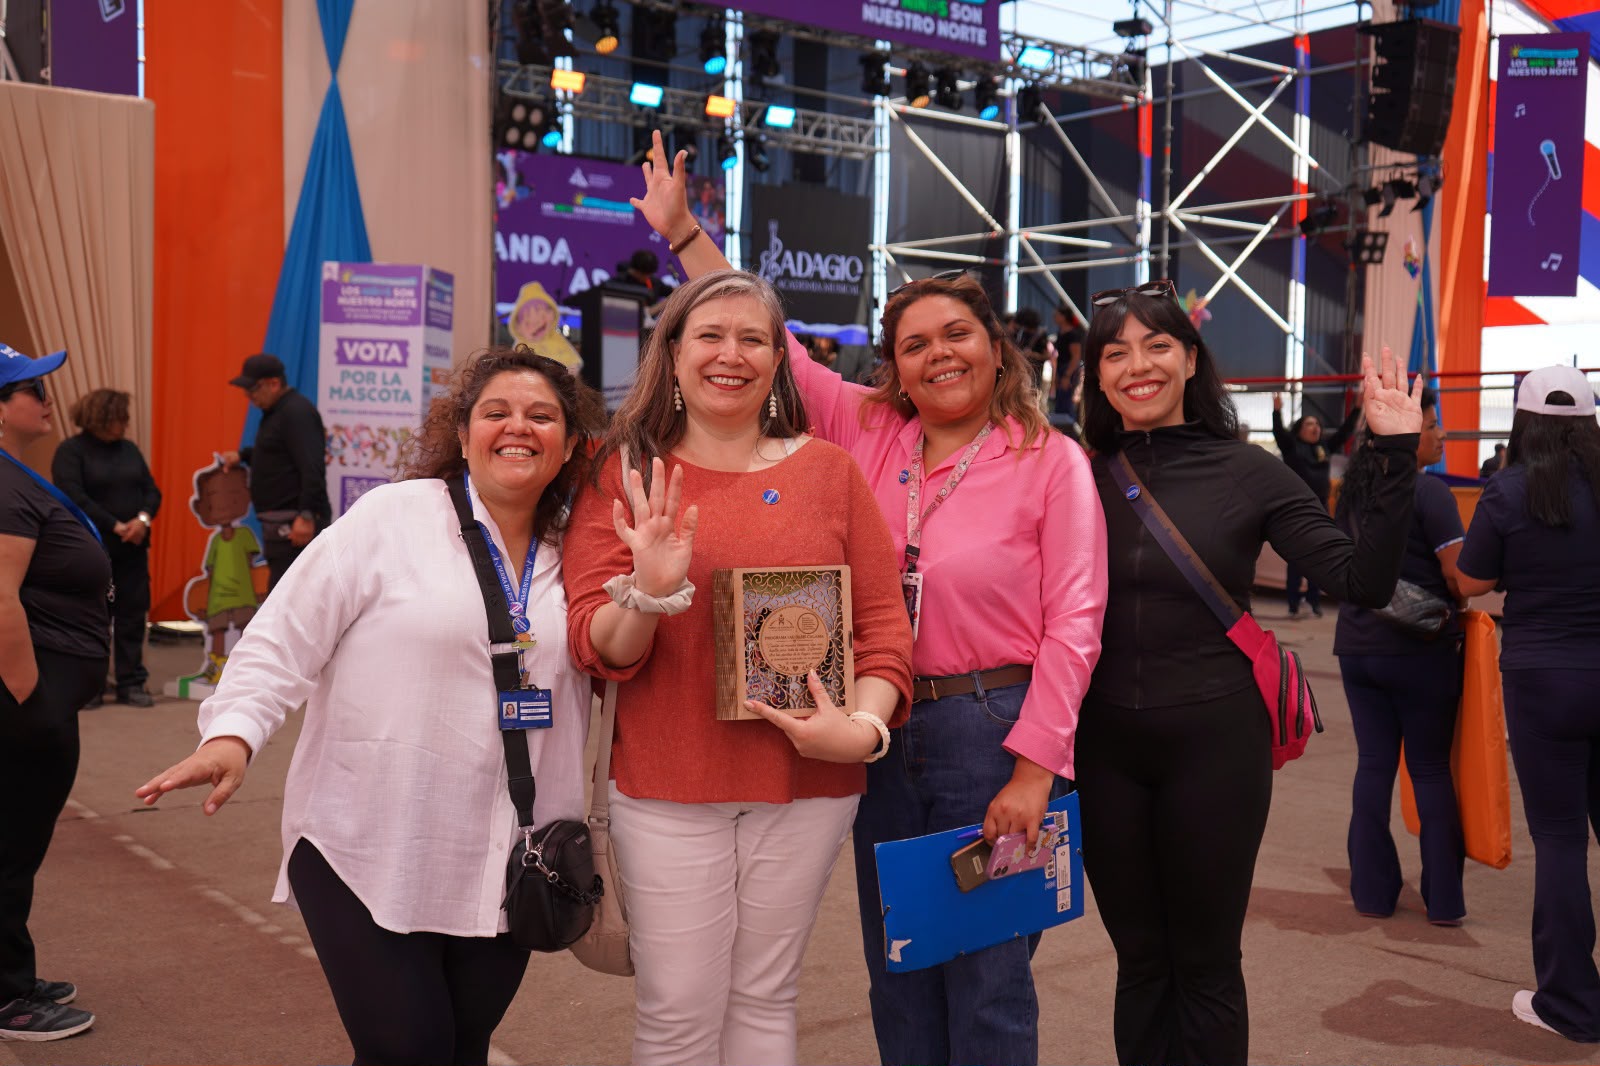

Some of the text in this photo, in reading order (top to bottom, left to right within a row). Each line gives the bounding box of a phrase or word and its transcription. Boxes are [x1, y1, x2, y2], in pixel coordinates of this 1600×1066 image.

[950, 2, 982, 24] SON
[862, 3, 987, 46] NUESTRO NORTE
[1507, 67, 1578, 76] NUESTRO NORTE
[1510, 58, 1528, 68] LOS
[1557, 58, 1576, 68] SON
[781, 250, 864, 282] ADAGIO
[343, 340, 403, 363] VOTA
[341, 370, 402, 386] POR LA
[329, 385, 412, 403] MASCOTA
